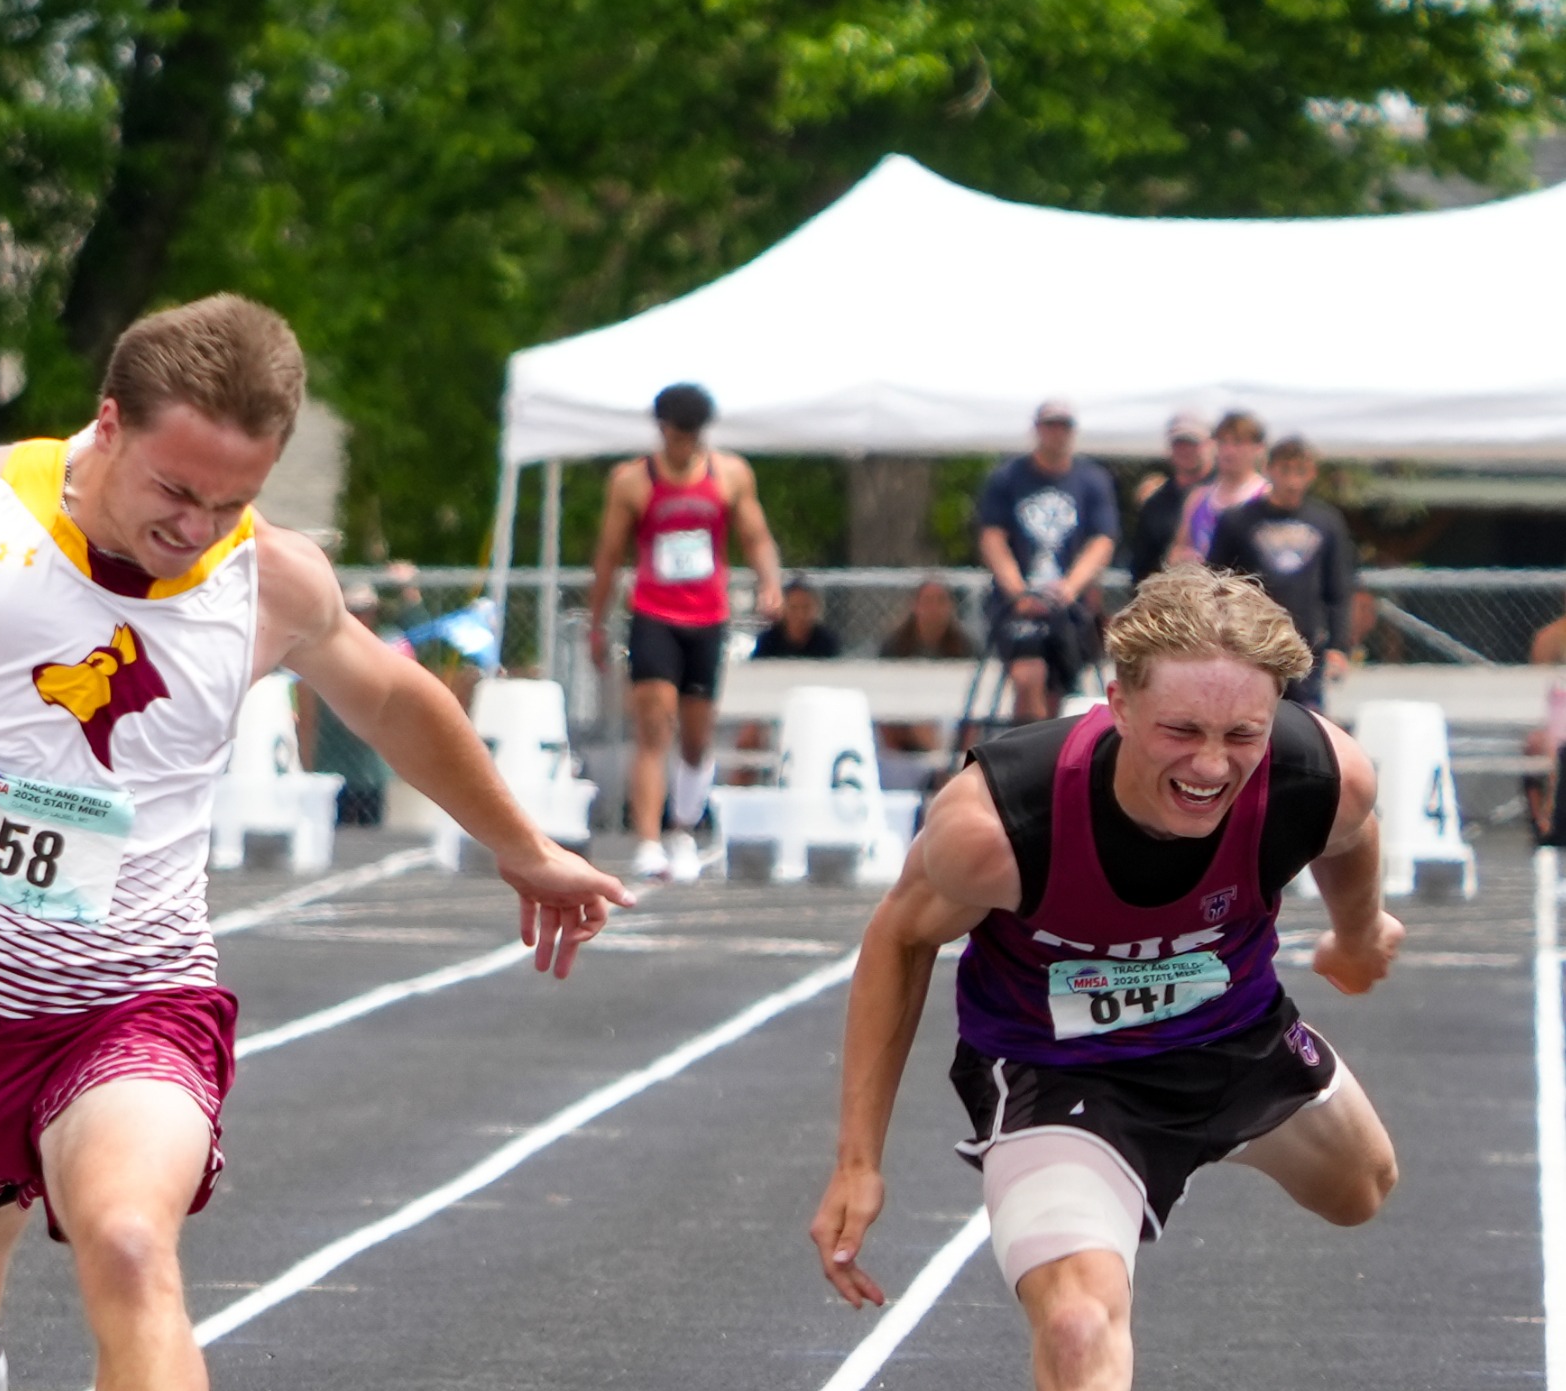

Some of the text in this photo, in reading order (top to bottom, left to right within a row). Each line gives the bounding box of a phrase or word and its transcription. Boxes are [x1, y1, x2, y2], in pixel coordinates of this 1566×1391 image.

[13, 789, 108, 818] 2026 STATE MEET
[17, 778, 54, 797] TRACK
[55, 789, 80, 802] AND
[81, 795, 112, 809] FIELD
[1424, 764, 1446, 838] 4
[1073, 976, 1109, 989] MHSA
[1112, 963, 1148, 975] TRACK
[1172, 961, 1199, 970] FIELD
[1113, 976, 1141, 986] 2026
[1143, 973, 1174, 983] STATE
